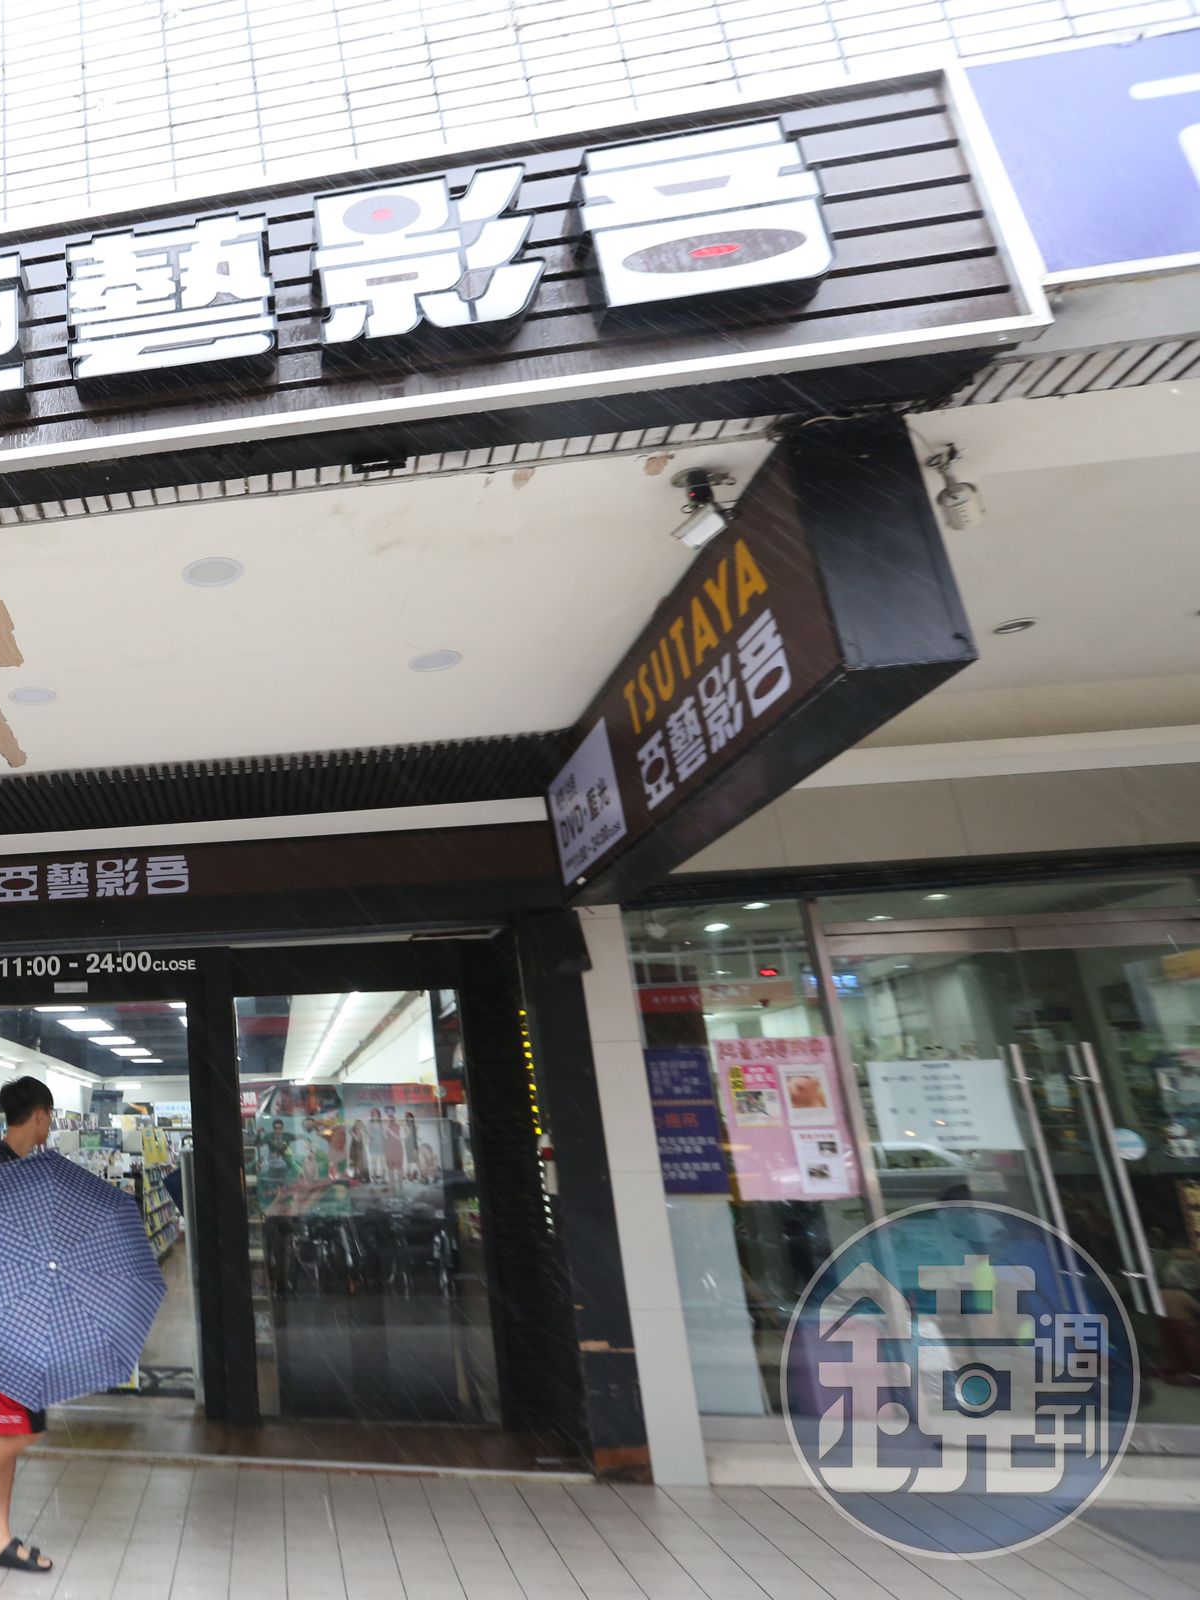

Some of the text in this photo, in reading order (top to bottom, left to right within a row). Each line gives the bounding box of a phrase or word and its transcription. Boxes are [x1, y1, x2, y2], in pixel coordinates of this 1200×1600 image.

[623, 538, 769, 735] TSUTAYA
[636, 607, 793, 811] 亞藝影音
[0, 956, 61, 977] 11:00
[86, 951, 151, 975] 24:00
[153, 959, 197, 972] CLOSE
